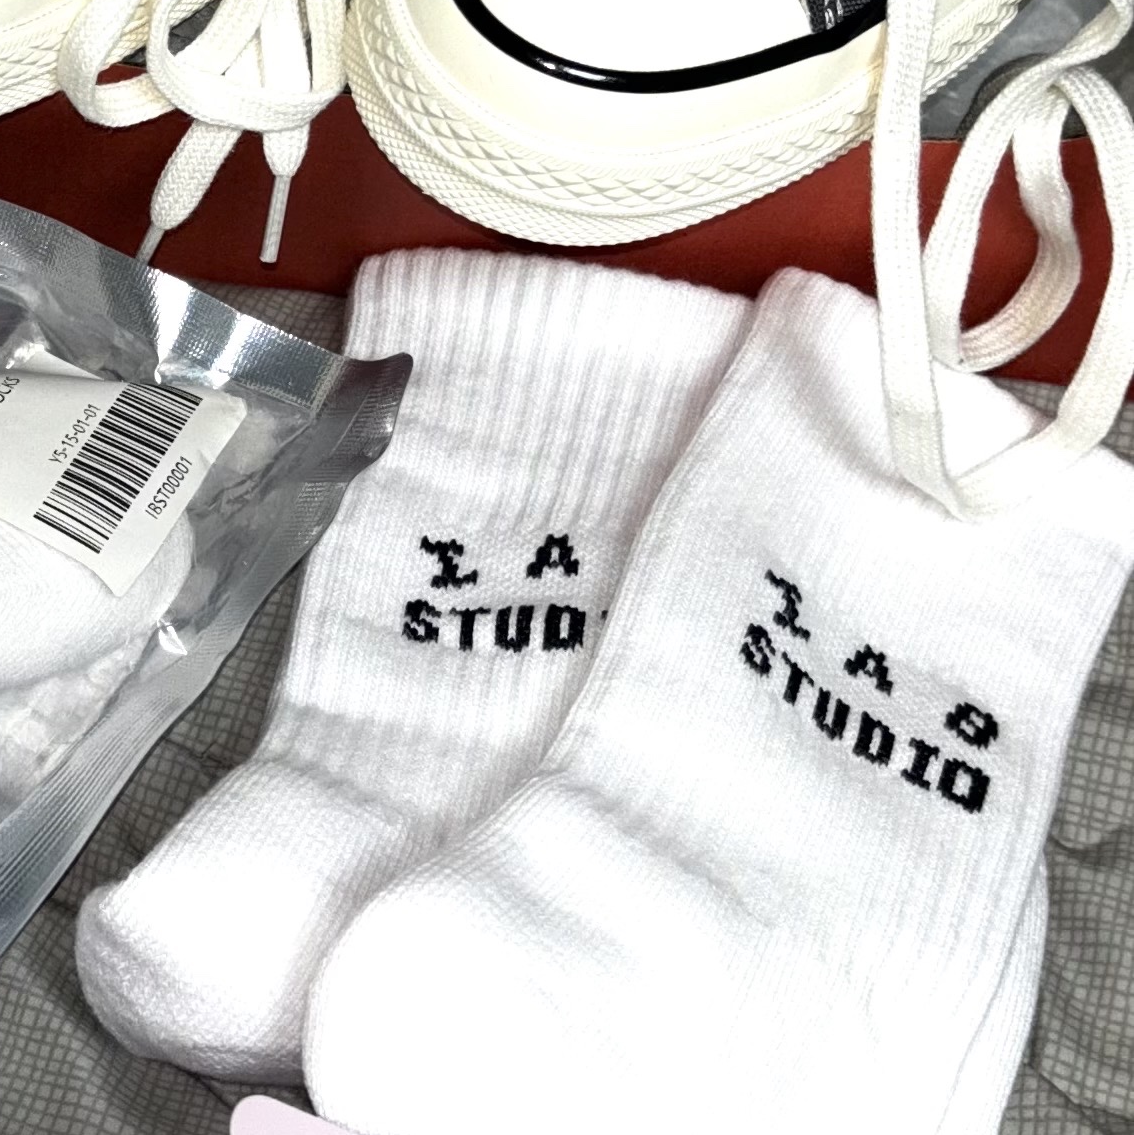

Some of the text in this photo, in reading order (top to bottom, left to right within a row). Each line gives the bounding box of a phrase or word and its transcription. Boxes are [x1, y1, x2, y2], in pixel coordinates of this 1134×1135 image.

[145, 456, 192, 519] IBST00001
[401, 599, 608, 653] STUD
[739, 623, 991, 815] STUDIO
